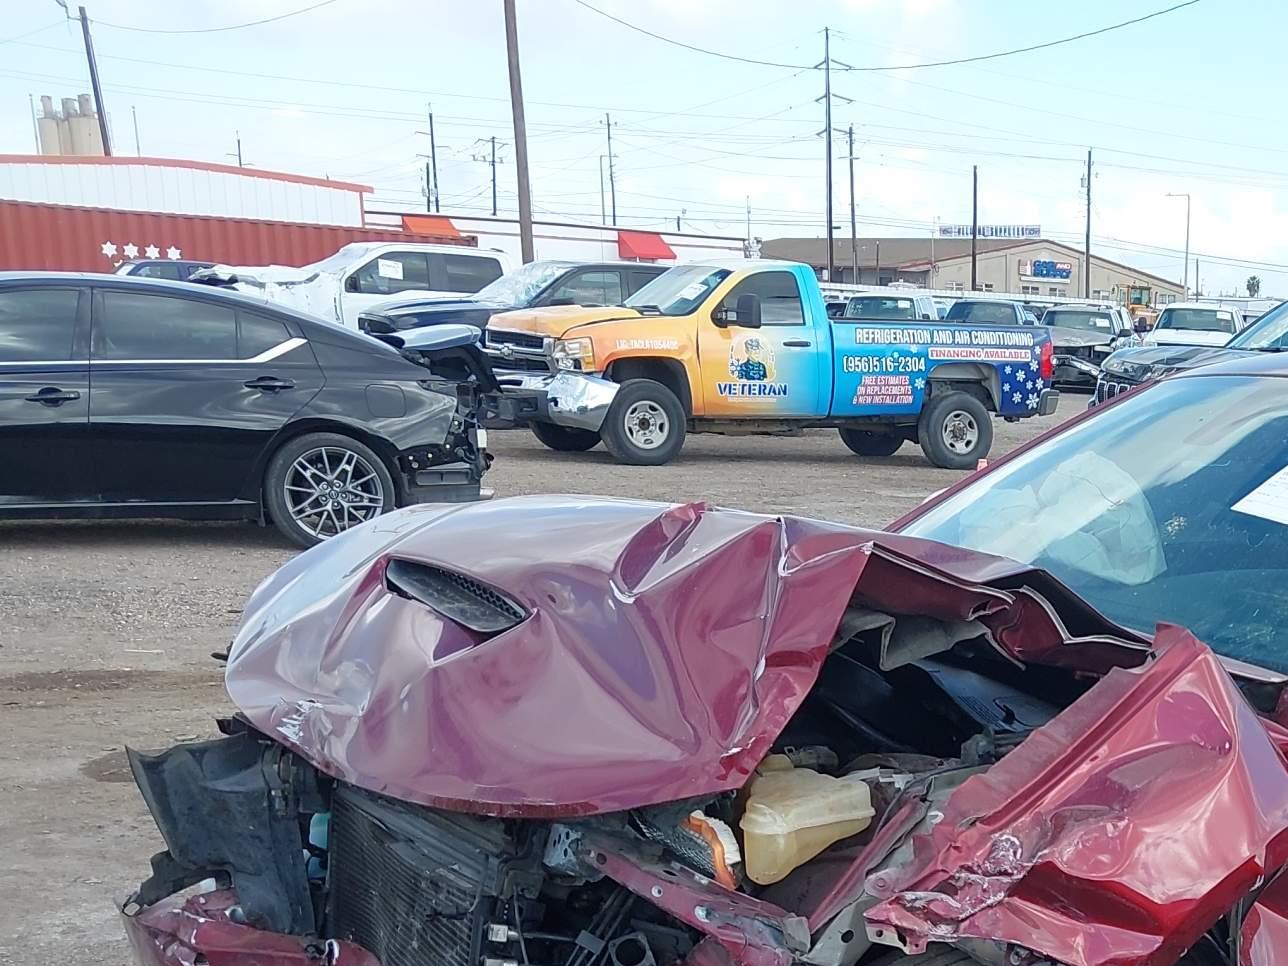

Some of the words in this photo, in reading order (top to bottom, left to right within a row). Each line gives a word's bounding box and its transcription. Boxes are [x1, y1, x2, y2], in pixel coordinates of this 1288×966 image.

[856, 328, 931, 344] REFRIGERATION
[933, 329, 952, 345] AND
[954, 330, 971, 345] AIR
[971, 330, 1034, 346] CONDITIONING
[930, 350, 983, 359] FINANCING
[984, 350, 1030, 359] AVAILABLE
[843, 355, 926, 373] (956)516-2304
[862, 376, 876, 385] FREE
[877, 376, 910, 385] ESTIMATES
[717, 382, 788, 396] VETERAN
[857, 386, 866, 395] ON
[866, 386, 912, 395] REPLACEMENTS
[858, 395, 872, 404] NEW
[872, 395, 914, 404] INSTALLATION
